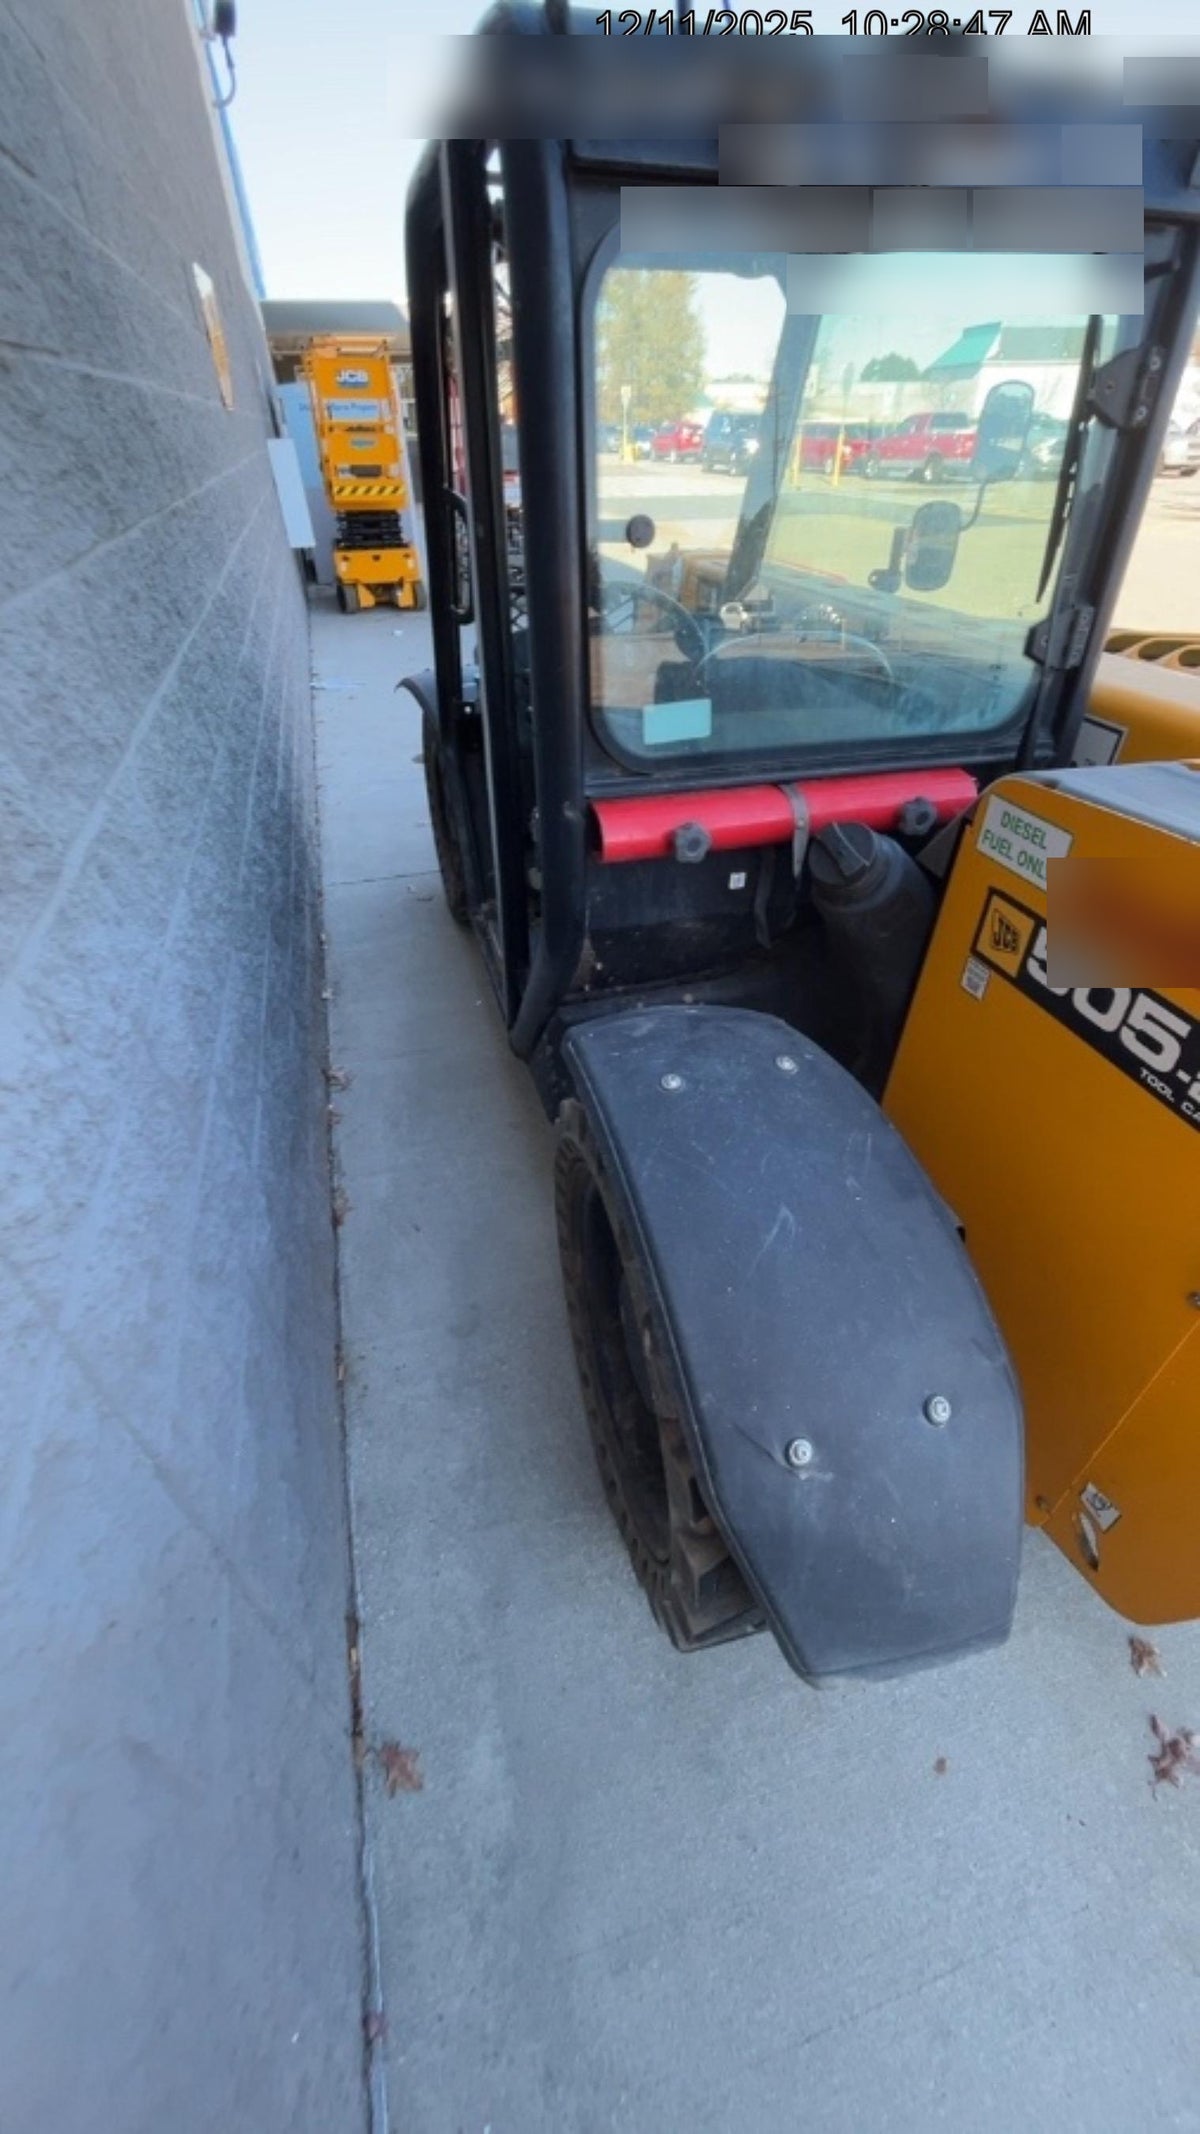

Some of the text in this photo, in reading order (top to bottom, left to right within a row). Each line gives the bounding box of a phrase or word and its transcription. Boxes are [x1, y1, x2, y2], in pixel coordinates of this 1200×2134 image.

[1000, 811, 1047, 850] DIESEL
[981, 829, 1047, 880] FUEL ONL
[1140, 1067, 1175, 1103] TOOL
